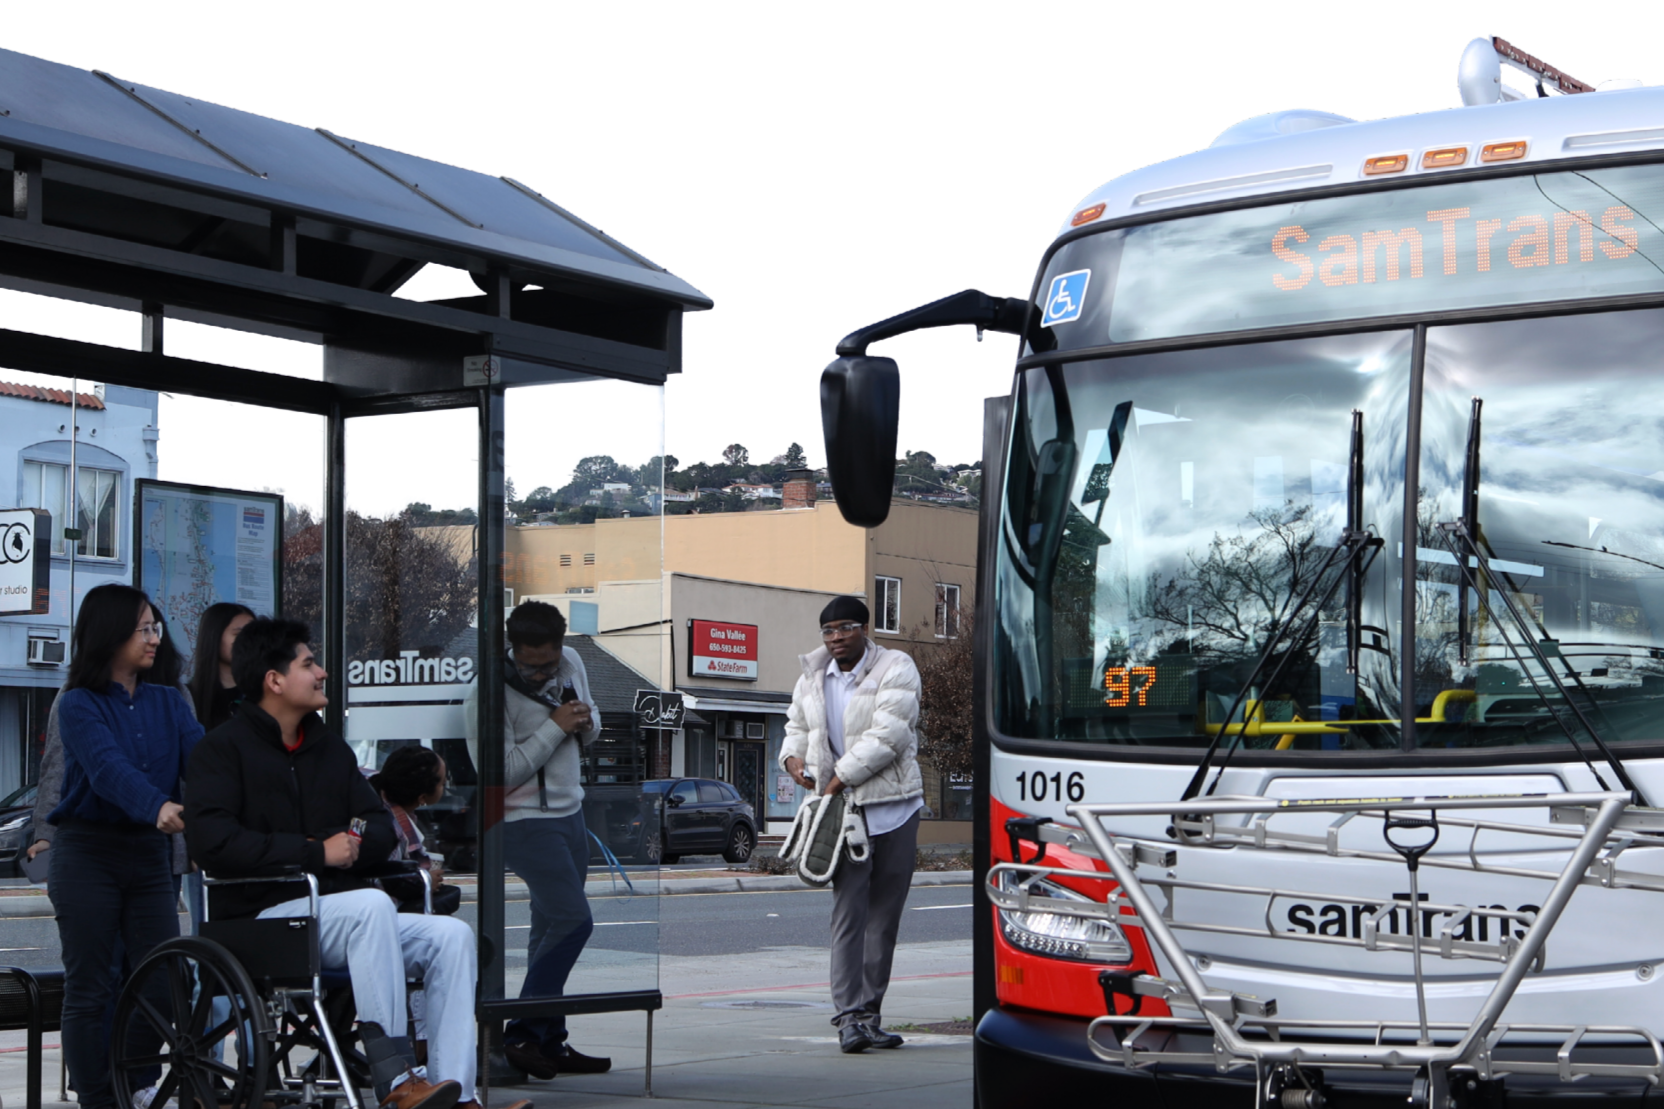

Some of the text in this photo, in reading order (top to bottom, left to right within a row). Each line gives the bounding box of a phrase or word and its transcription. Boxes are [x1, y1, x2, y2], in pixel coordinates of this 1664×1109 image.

[1271, 205, 1639, 291] SamTrans
[4, 585, 28, 595] studio
[710, 627, 726, 639] Gina
[1105, 666, 1156, 707] 97
[1015, 770, 1085, 803] 1016
